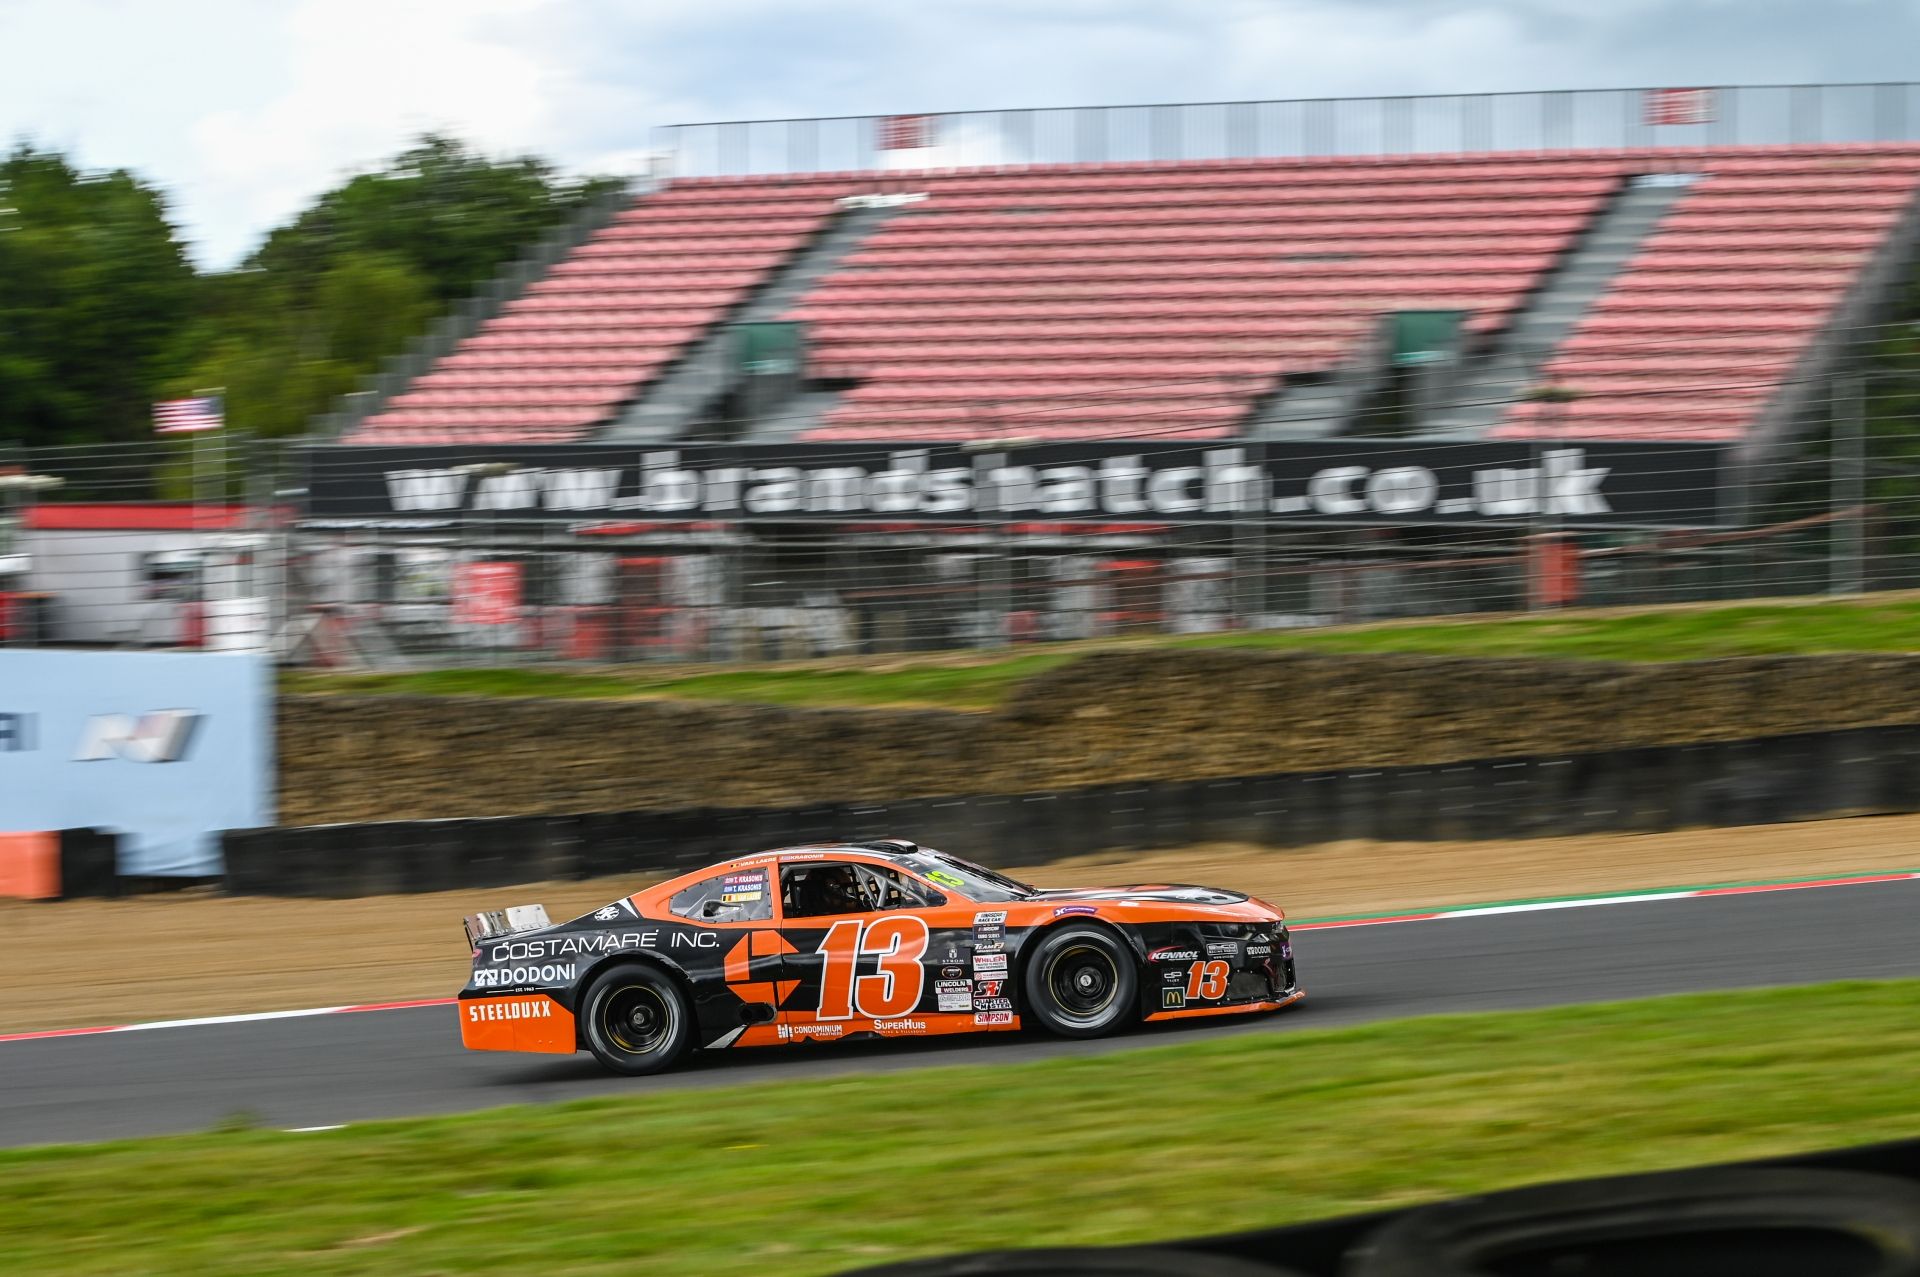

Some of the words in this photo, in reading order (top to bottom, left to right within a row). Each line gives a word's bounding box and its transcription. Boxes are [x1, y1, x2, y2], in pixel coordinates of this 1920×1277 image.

[384, 449, 1612, 516] www.brandshatch.co.uk
[492, 932, 658, 962] COSTAMARE
[671, 932, 720, 948] INC.
[1151, 950, 1199, 960] KENNOL
[500, 963, 576, 985] DODONI
[815, 915, 930, 1021] 13
[937, 980, 966, 988] LINCOLN
[1185, 960, 1230, 1000] 13
[794, 1024, 843, 1034] CONDOMINIUM
[977, 1013, 1010, 1023] SIMPSON
